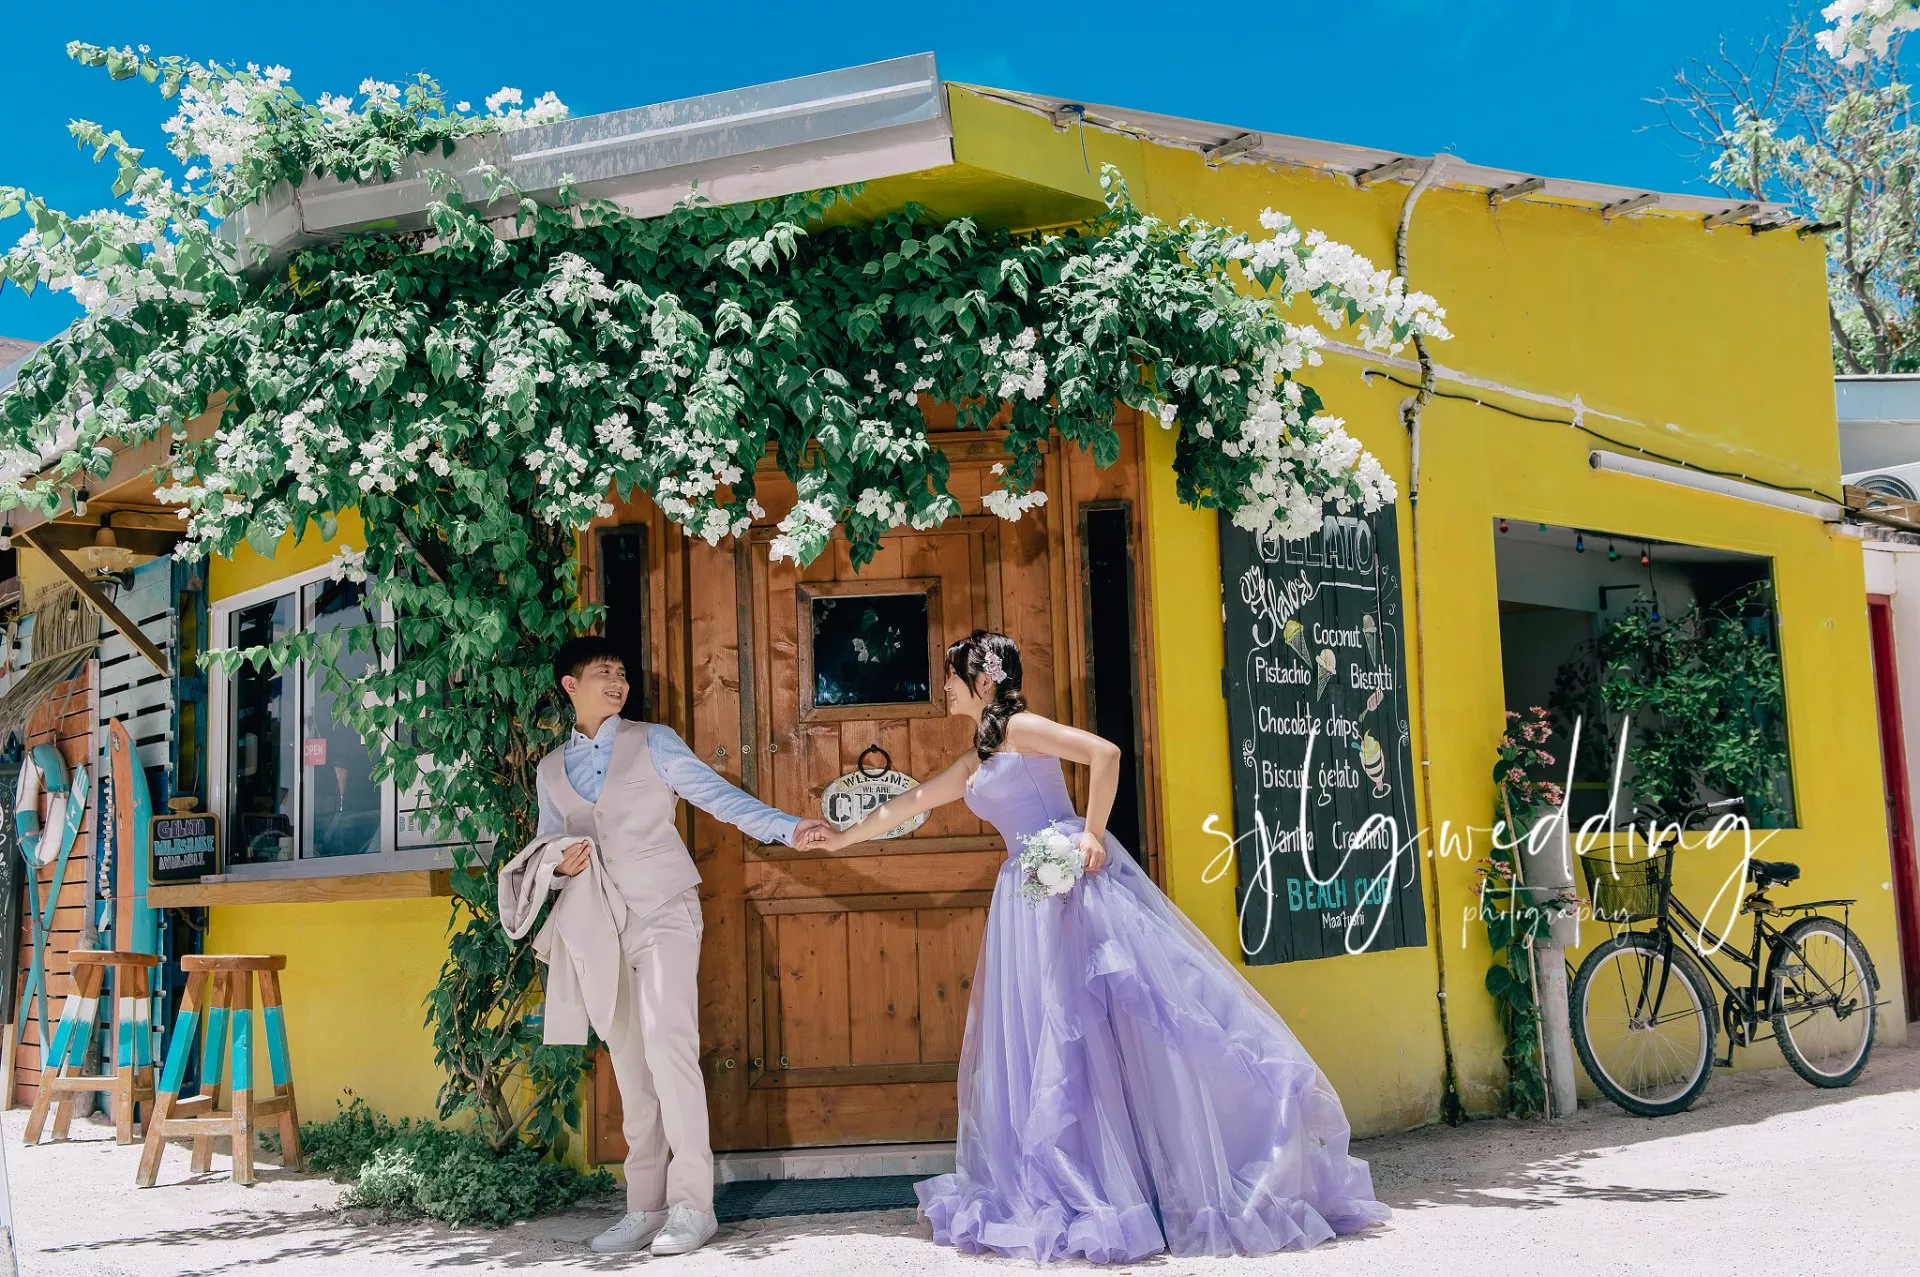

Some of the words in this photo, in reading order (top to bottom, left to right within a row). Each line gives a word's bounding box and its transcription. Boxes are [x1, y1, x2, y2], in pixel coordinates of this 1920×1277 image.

[1313, 622, 1362, 648] Coconut
[1255, 657, 1311, 685] Pistachio
[1350, 663, 1393, 691] Biscotti
[1259, 701, 1321, 735] Chocolate
[1326, 704, 1359, 748] chips
[304, 744, 323, 757] OPEN
[1262, 760, 1313, 789] Biscui
[1318, 759, 1359, 806] gelato
[156, 819, 206, 840] GELATO
[1266, 820, 1314, 853] Vania
[1287, 877, 1347, 911] BEACH
[1354, 877, 1393, 905] CLUB
